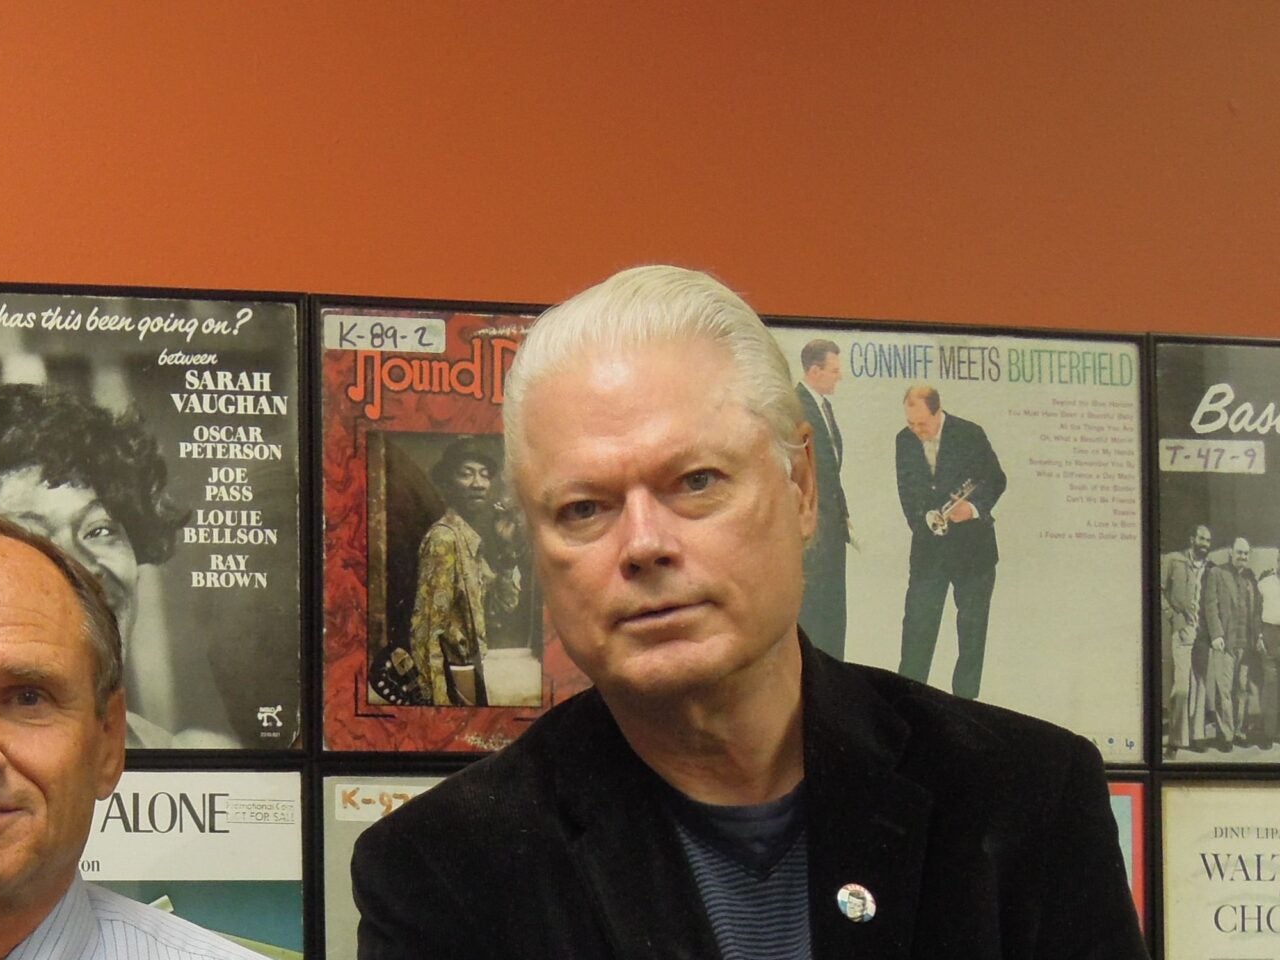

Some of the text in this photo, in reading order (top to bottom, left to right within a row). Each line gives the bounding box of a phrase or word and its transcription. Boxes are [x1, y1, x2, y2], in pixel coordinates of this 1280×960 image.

[41, 306, 82, 331] this
[86, 306, 135, 331] been
[137, 312, 199, 342] going
[201, 307, 253, 336] on?
[339, 321, 434, 348] K-89-2
[157, 348, 219, 366] between
[850, 341, 1134, 388] CONNIFF MEETS BUTTERFIELD
[185, 369, 271, 393] SARAH
[170, 393, 288, 415] VAUGHAN
[1190, 383, 1280, 434] Bas
[193, 425, 263, 443] OSCAR
[179, 442, 282, 460] PETERSON
[208, 467, 248, 484] JOE
[205, 485, 253, 502] PASS
[196, 509, 263, 526] LOUIE
[183, 527, 278, 545] BELLSON
[209, 554, 250, 571] RAY
[191, 571, 268, 589] BROWN
[100, 791, 230, 834] ALONE
[1214, 826, 1280, 839] DINU LIP
